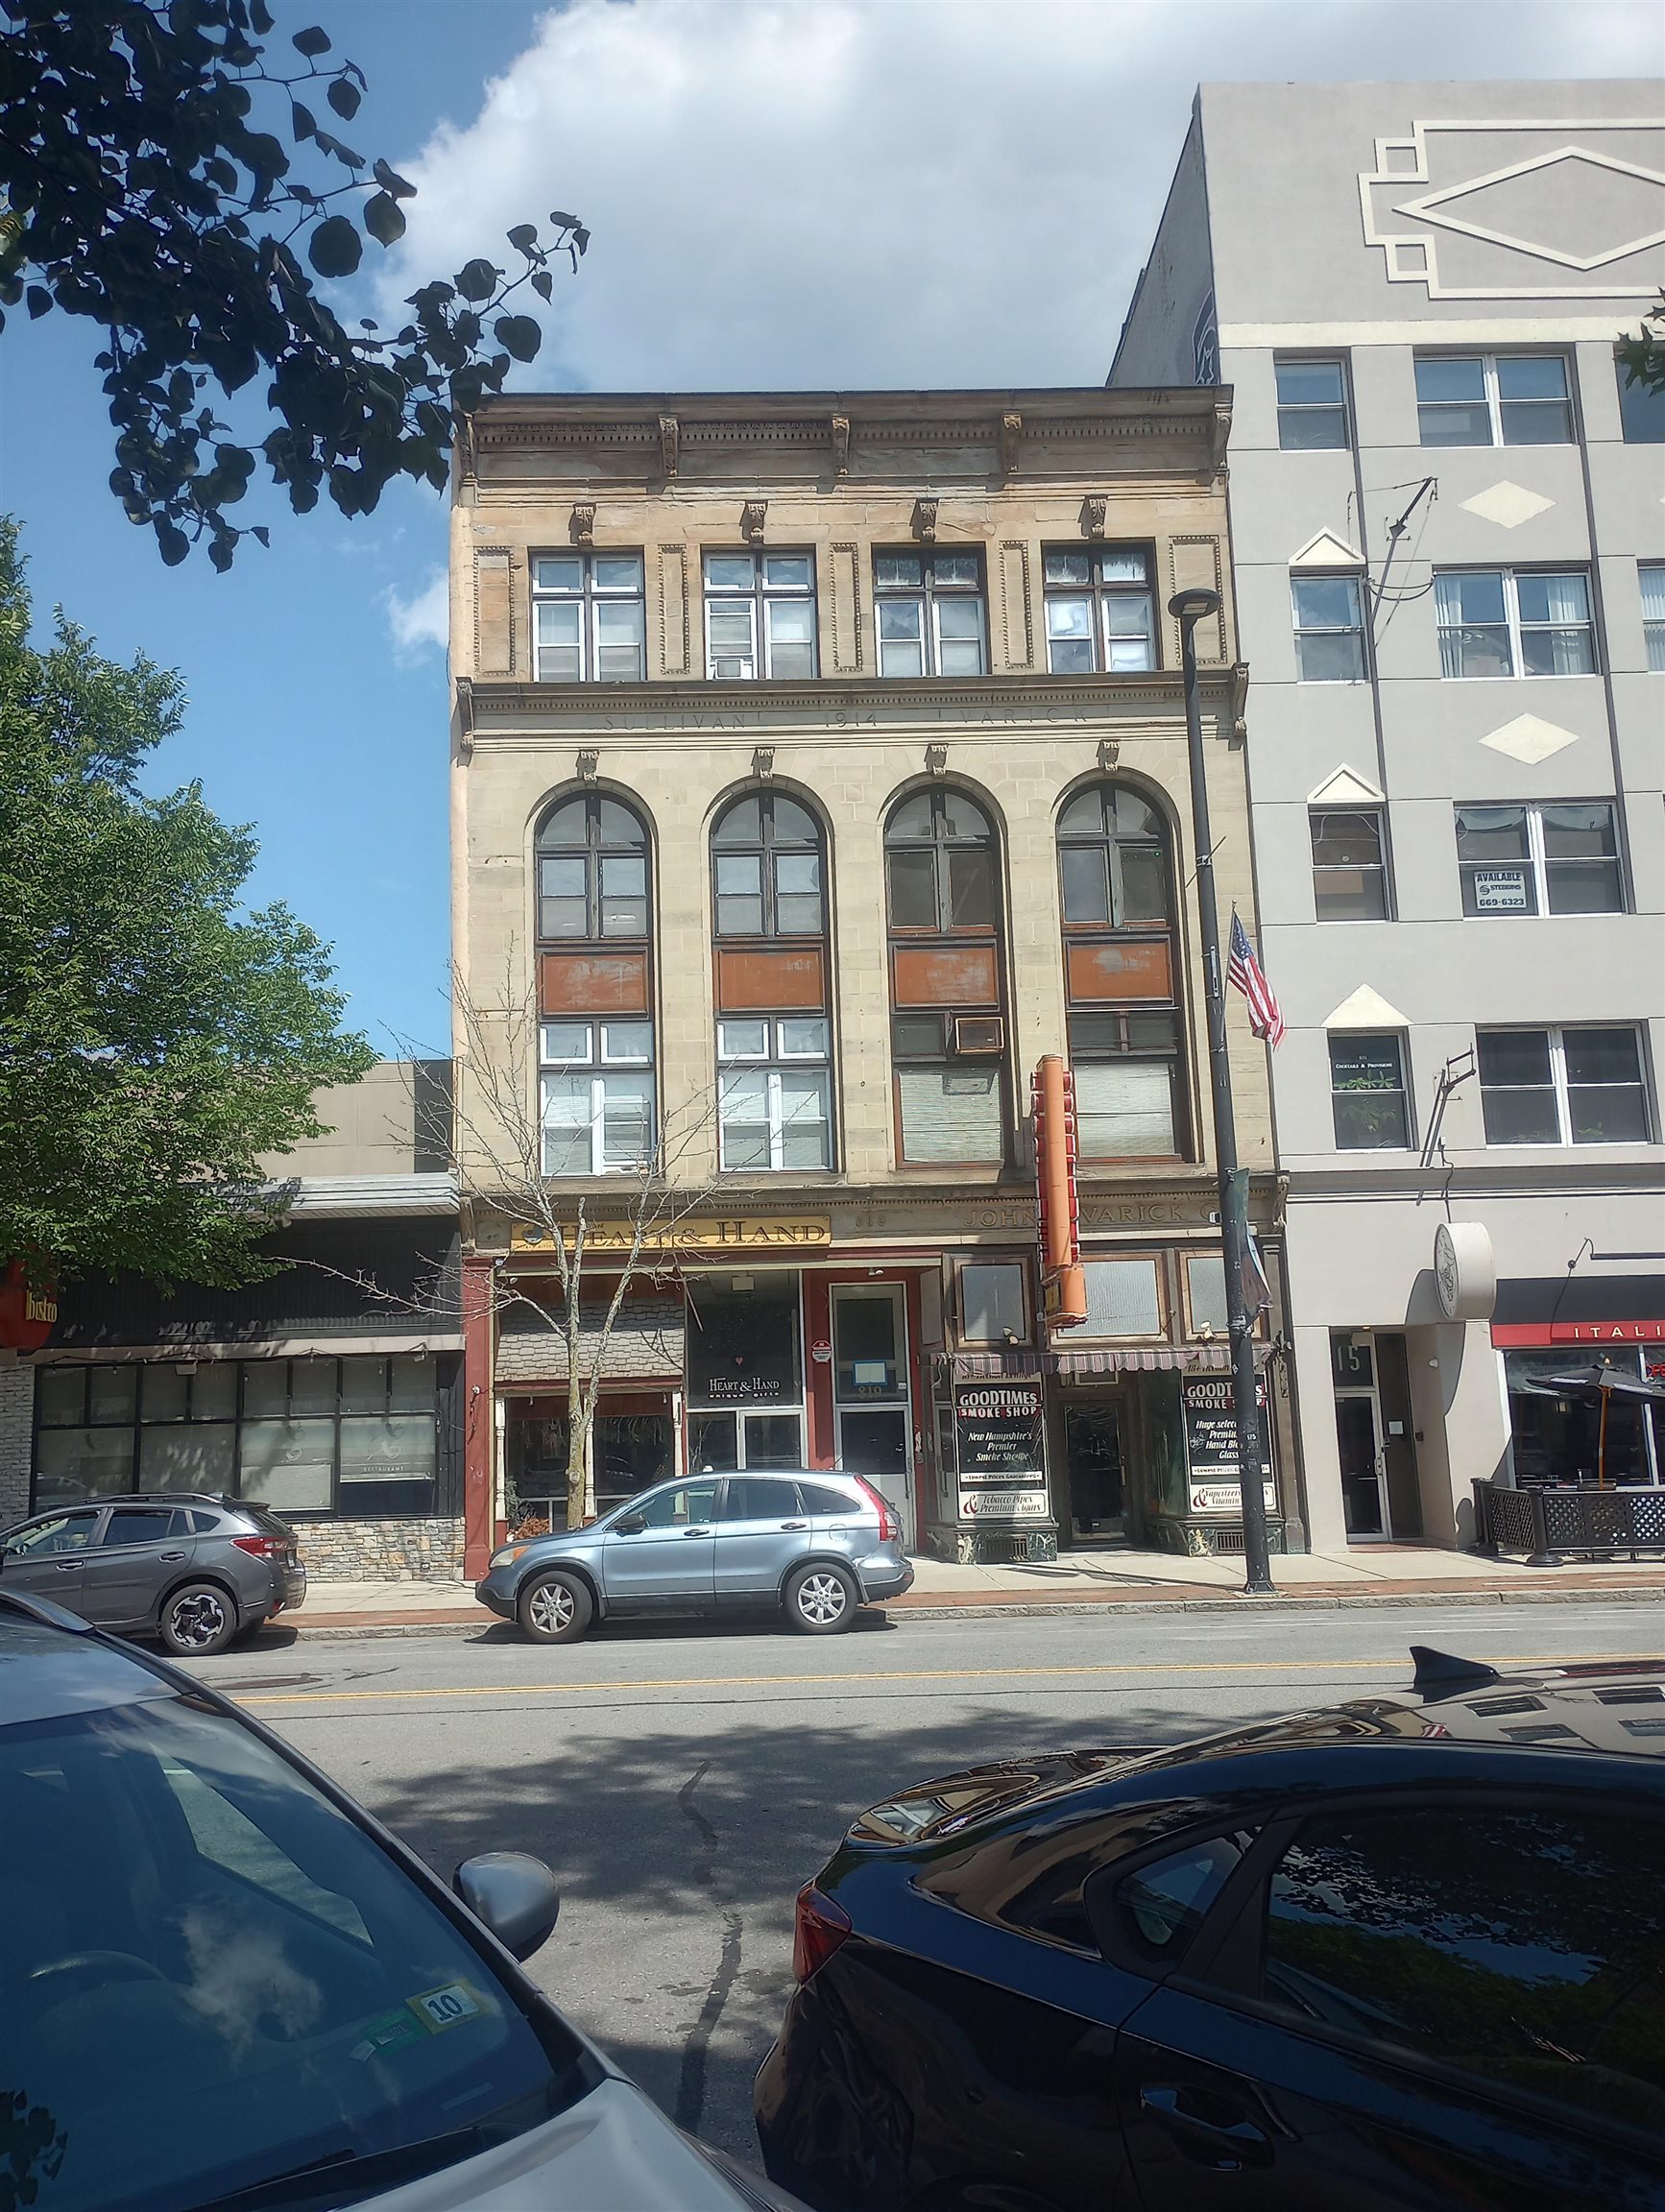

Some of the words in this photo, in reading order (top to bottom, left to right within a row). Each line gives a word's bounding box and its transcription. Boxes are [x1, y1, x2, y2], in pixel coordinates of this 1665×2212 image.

[603, 714, 745, 730] SULLIVAN
[824, 711, 877, 727] 1914
[960, 706, 1088, 725] VARICK
[1477, 873, 1521, 881] AVAILABLE
[1479, 898, 1524, 906] 669-6323
[963, 1210, 1037, 1227] JOHN
[1080, 1204, 1188, 1223] VARICK
[716, 1220, 826, 1245] HAND
[26, 1289, 58, 1323] bistro
[709, 1379, 738, 1391] HEART
[752, 1377, 780, 1390] HAND
[959, 1390, 1038, 1407] GOODTIMES
[1189, 1399, 1227, 1409] SMOKE
[961, 1407, 1001, 1418] SMOKE
[1005, 1407, 1037, 1417] SHOP
[1195, 1420, 1215, 1431] Huge
[968, 1431, 985, 1442] New
[987, 1442, 1018, 1452] Premier
[1205, 1440, 1227, 1450] Hand
[1219, 1450, 1240, 1459] Glass
[427, 1994, 463, 2022] 10
